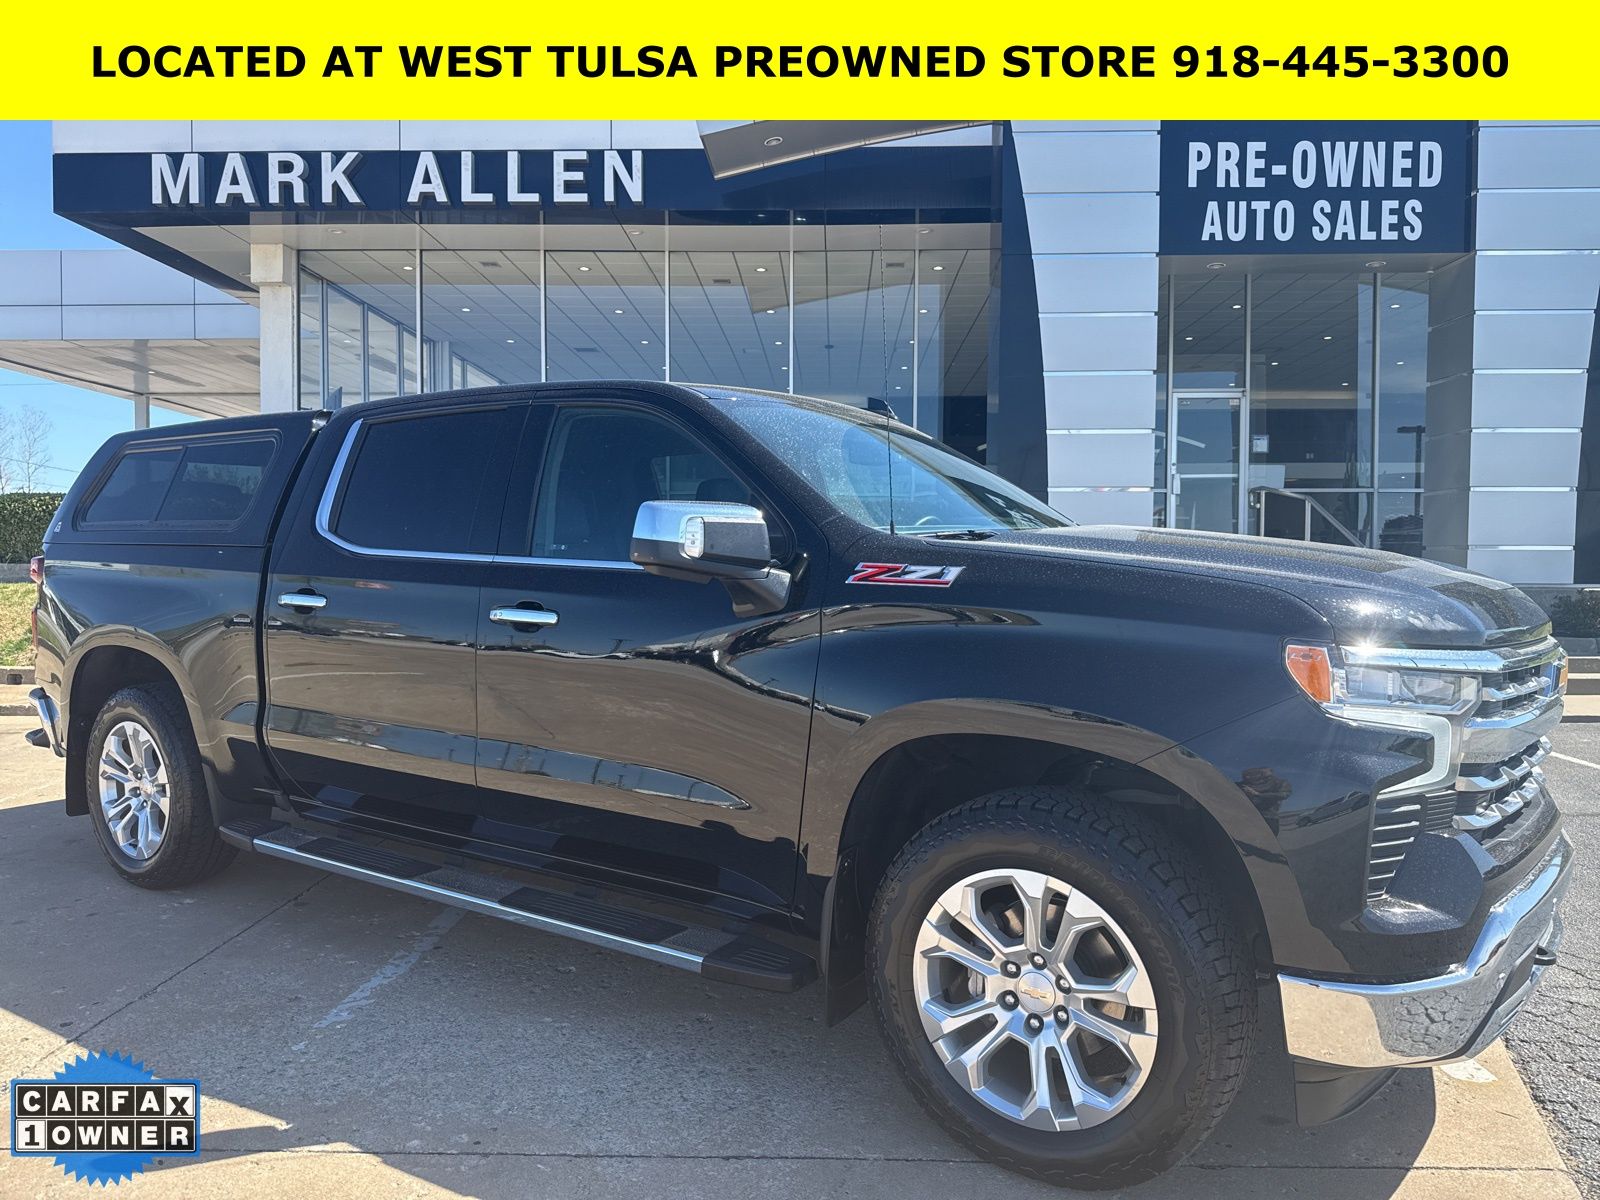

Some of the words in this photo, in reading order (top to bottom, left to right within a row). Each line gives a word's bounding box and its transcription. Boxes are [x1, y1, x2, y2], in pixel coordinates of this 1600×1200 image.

[151, 151, 365, 206] MARK
[406, 150, 645, 205] ALLEN
[1187, 140, 1443, 189] PRE-OWNED
[1201, 199, 1295, 242] AUTO
[1312, 199, 1423, 241] SALES
[845, 562, 966, 588] Z71
